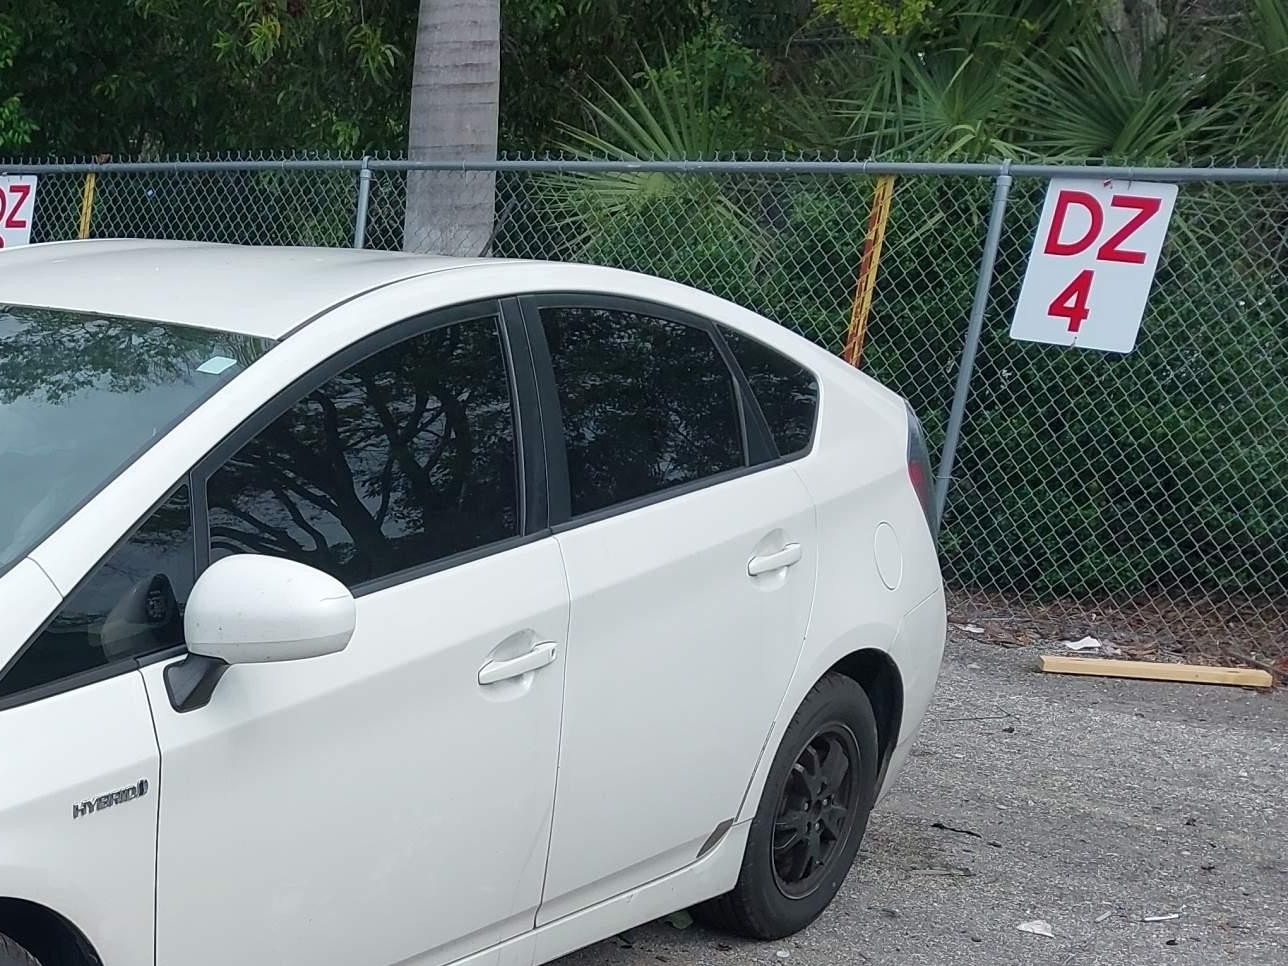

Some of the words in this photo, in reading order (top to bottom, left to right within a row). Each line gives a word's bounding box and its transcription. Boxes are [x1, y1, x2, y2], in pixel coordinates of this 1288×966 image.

[1044, 190, 1162, 264] DZ
[1047, 269, 1095, 332] 4
[73, 786, 137, 819] HYBRID
